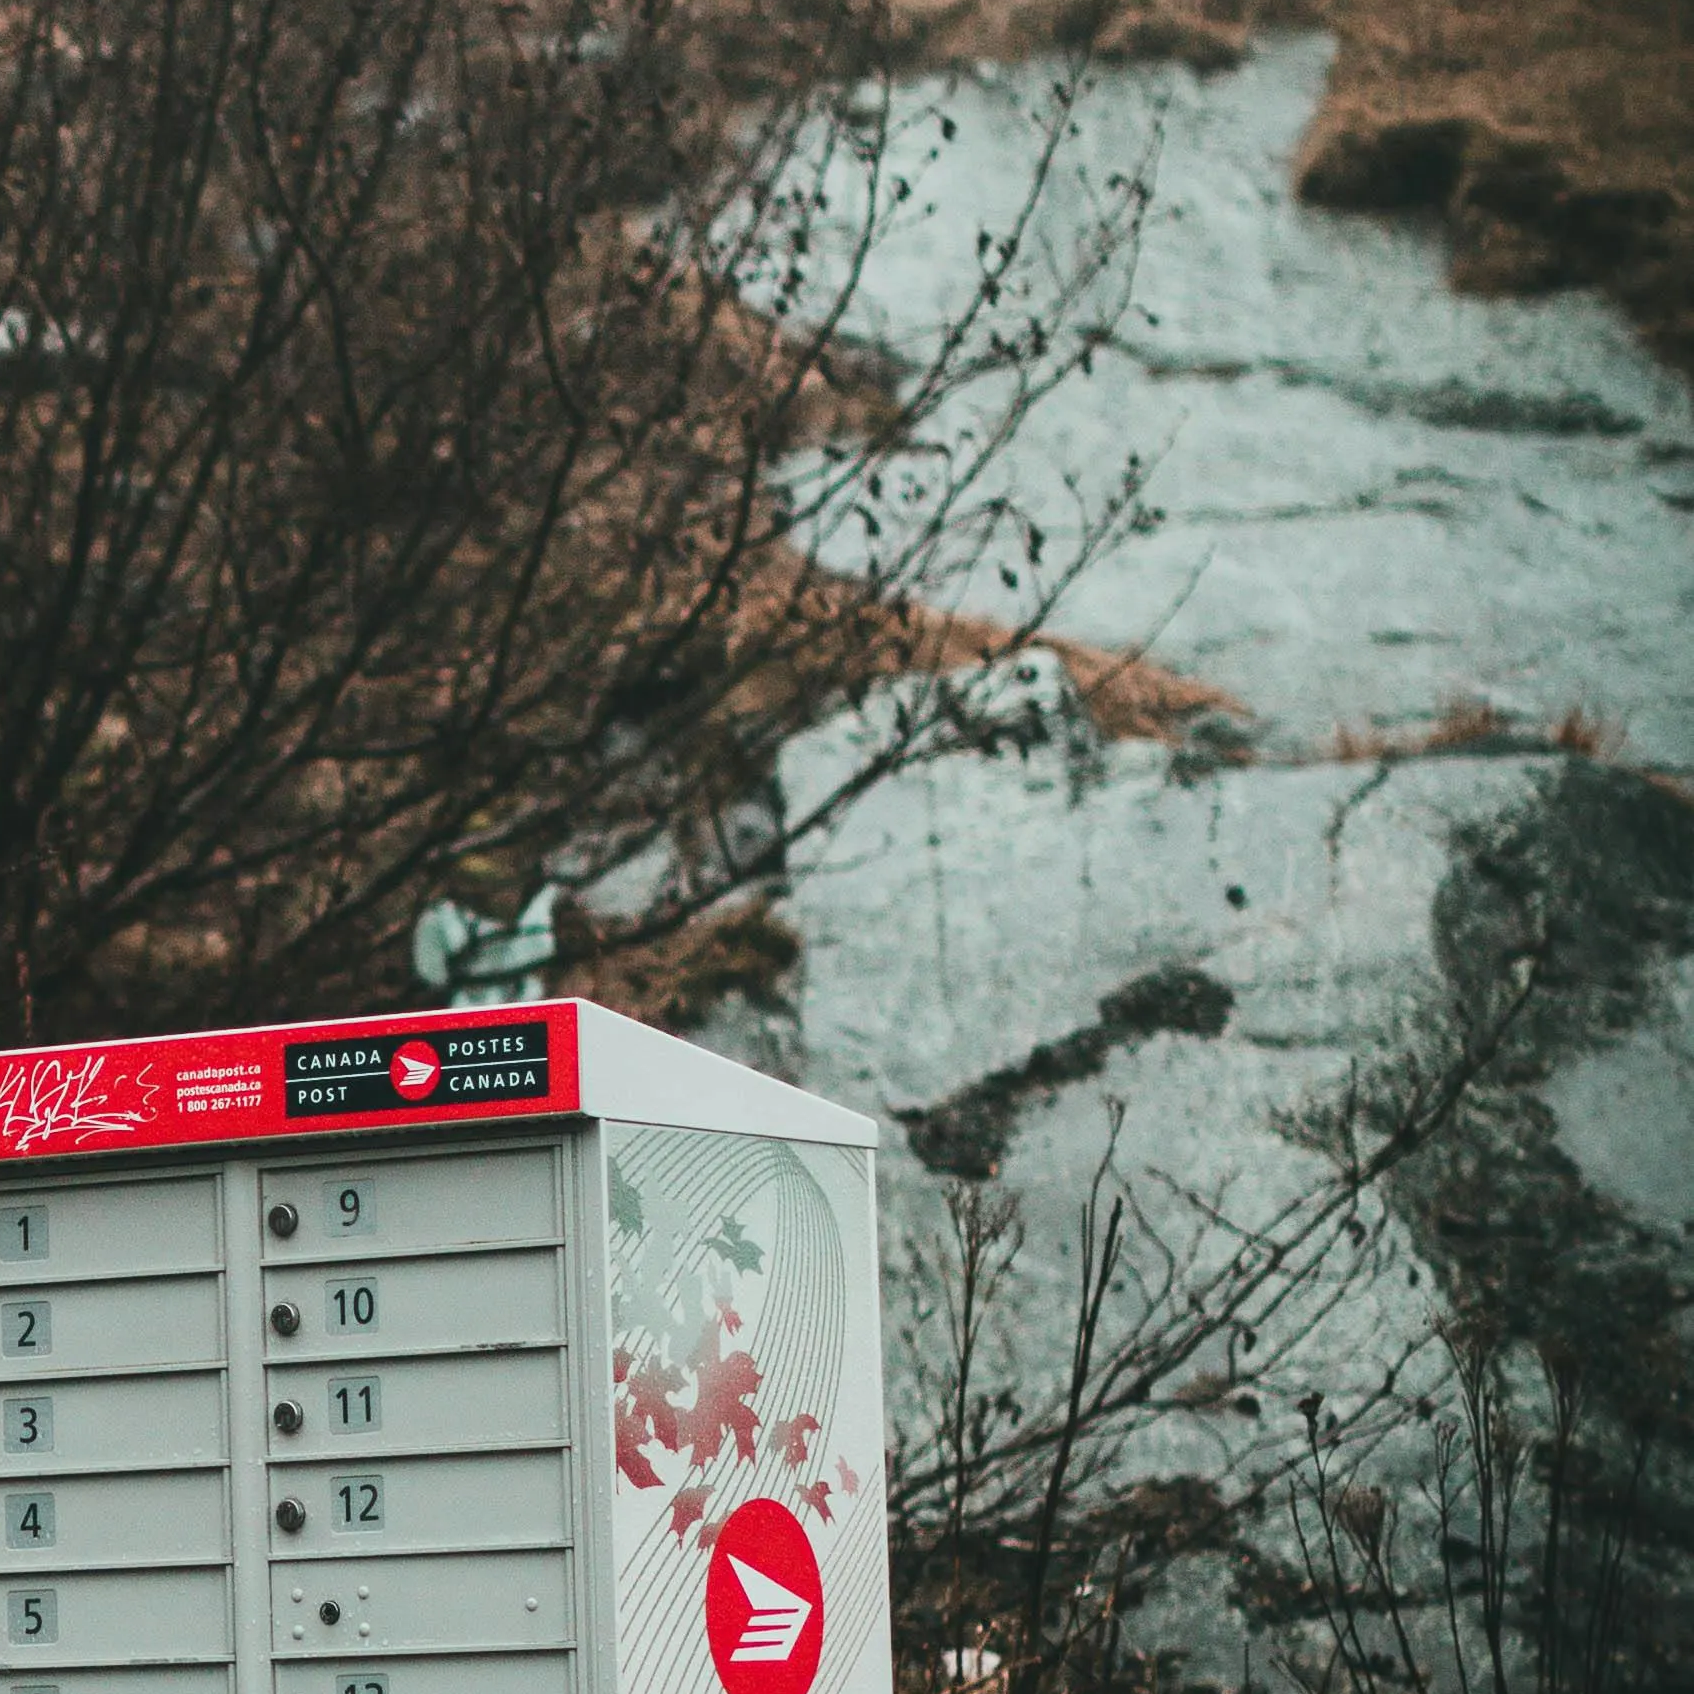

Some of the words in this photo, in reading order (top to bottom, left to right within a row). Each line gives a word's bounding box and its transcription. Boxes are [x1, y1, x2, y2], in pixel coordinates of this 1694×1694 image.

[296, 1049, 382, 1072] CANADA
[448, 1036, 524, 1057] POSTES
[176, 1064, 261, 1082] canadapost.ca
[176, 1080, 261, 1100] postescanada.ca
[448, 1070, 537, 1092] CANADA
[177, 1101, 184, 1113] 1
[187, 1099, 208, 1112] 800
[210, 1094, 262, 1110] 267-1177
[298, 1086, 347, 1105] POST
[339, 1188, 360, 1227] 9
[17, 1215, 30, 1252] 1
[333, 1286, 375, 1326] 10
[17, 1310, 37, 1348] 2
[335, 1385, 372, 1425] 11
[19, 1406, 38, 1445] 3
[20, 1502, 42, 1539] 4
[338, 1483, 380, 1523] 12
[24, 1597, 43, 1635] 5
